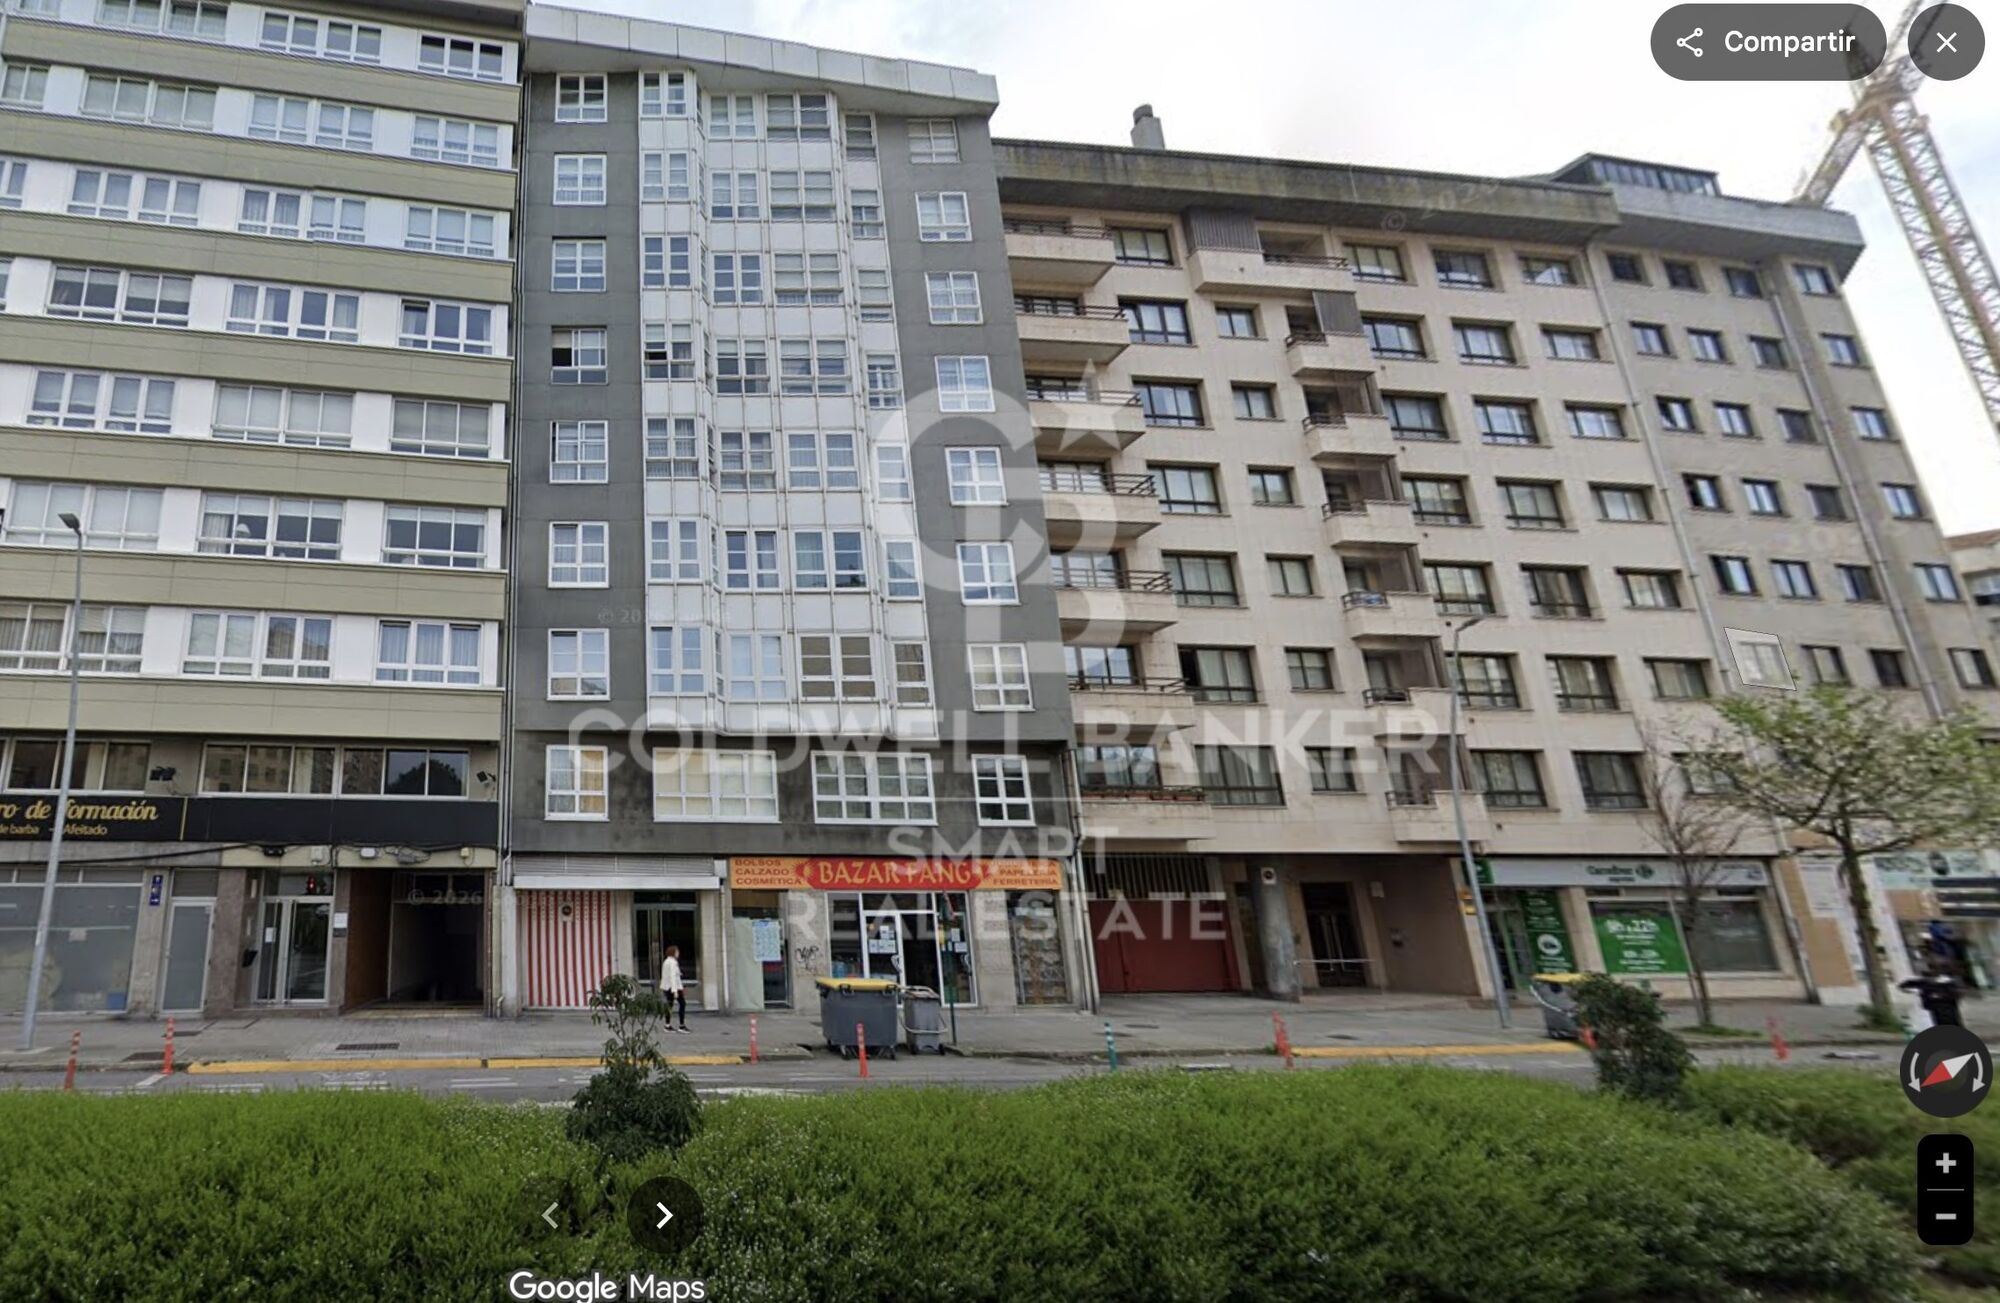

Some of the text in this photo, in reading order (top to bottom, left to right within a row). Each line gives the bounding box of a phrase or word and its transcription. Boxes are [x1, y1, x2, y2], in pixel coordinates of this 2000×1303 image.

[25, 800, 50, 819] de
[65, 799, 159, 820] formación
[11, 824, 40, 834] barba
[735, 867, 790, 876] CALZADO
[818, 860, 901, 884] BAZAR
